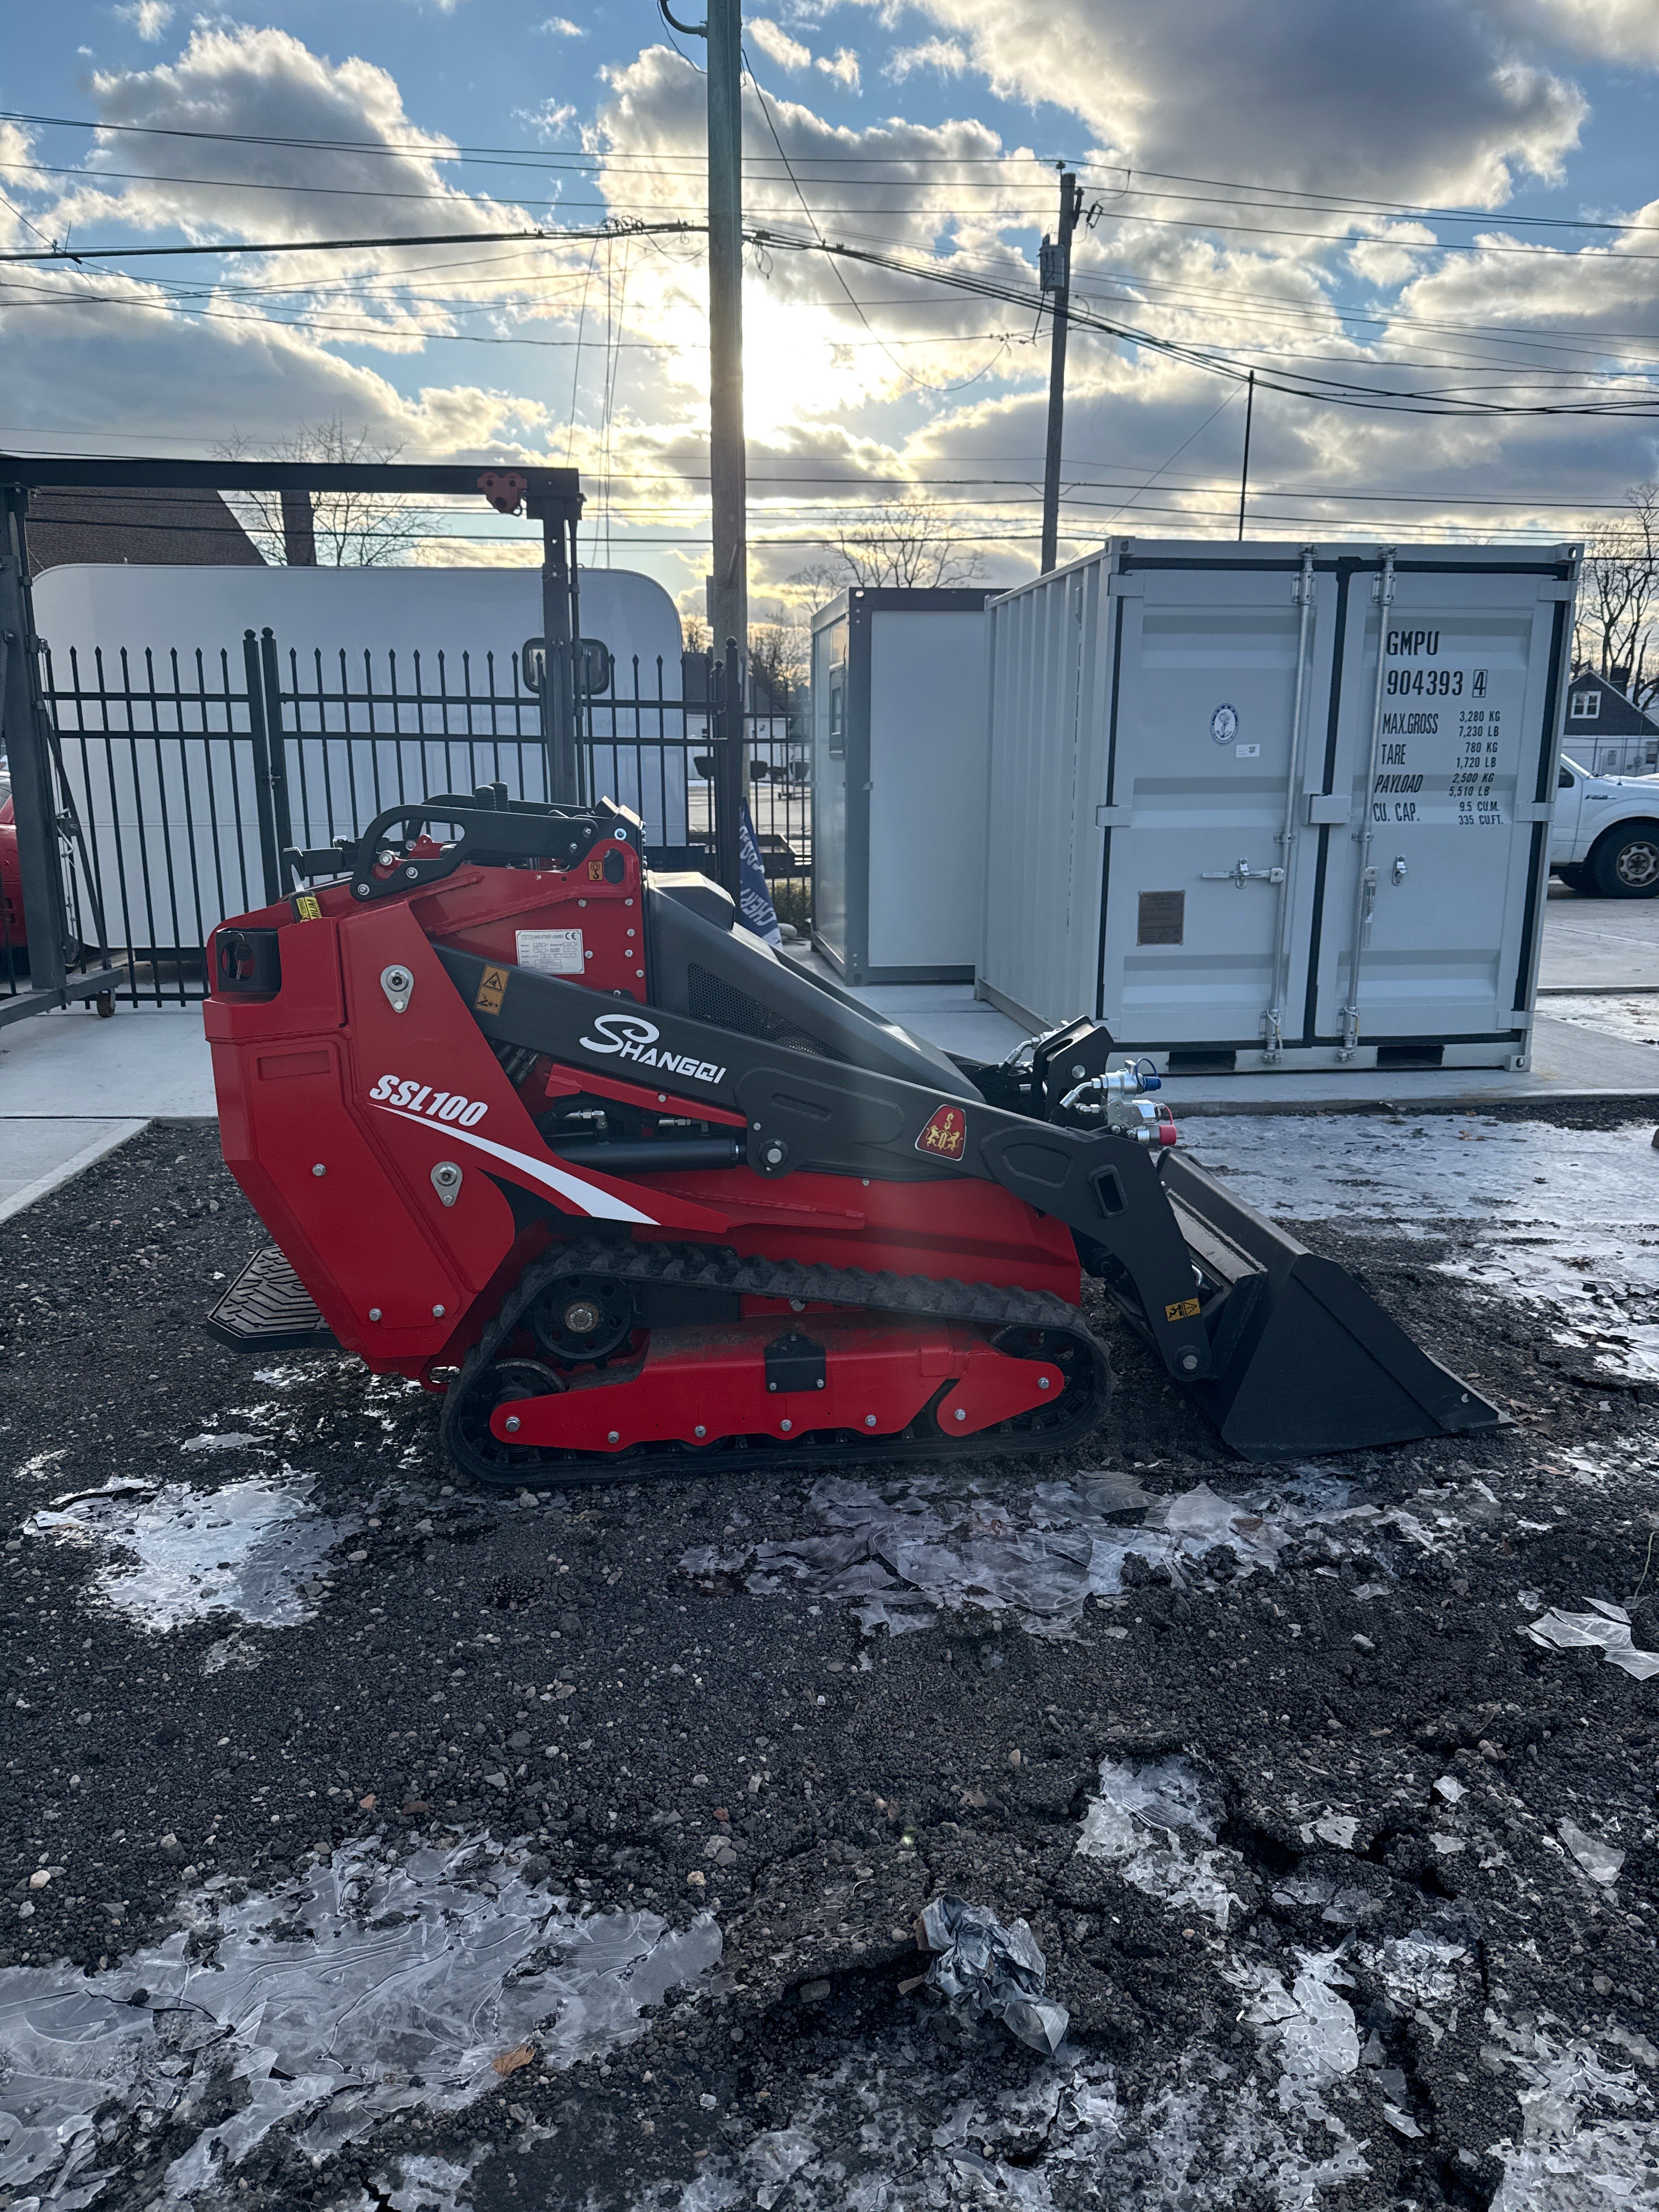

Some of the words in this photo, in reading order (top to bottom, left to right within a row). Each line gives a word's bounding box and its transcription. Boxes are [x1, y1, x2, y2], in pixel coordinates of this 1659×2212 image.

[1386, 631, 1440, 656] GMPU
[1387, 670, 1463, 695] 904393
[1474, 672, 1486, 695] 4
[1383, 713, 1438, 734] MAX.GROSS
[1459, 711, 1484, 723] 3,280
[1489, 711, 1500, 721] KG
[1459, 726, 1483, 737] 7,230
[1488, 726, 1499, 737] LB
[1381, 744, 1407, 765] TARE
[1465, 742, 1481, 753] 780
[1486, 742, 1498, 752] KG
[1457, 757, 1480, 769] 1,720
[1485, 757, 1496, 768] LB
[1374, 774, 1423, 793] PAYLOAD
[1453, 773, 1478, 783] 2,500
[1482, 772, 1494, 782] KG
[1449, 786, 1474, 797] 5,510
[1478, 786, 1489, 795] LB
[1373, 803, 1391, 822] CU.
[1395, 803, 1420, 822] CAP.
[1459, 802, 1472, 811] 9.5
[1458, 815, 1474, 825] 335
[579, 1014, 726, 1084] SHANGQI
[369, 1075, 488, 1126] SSL100
